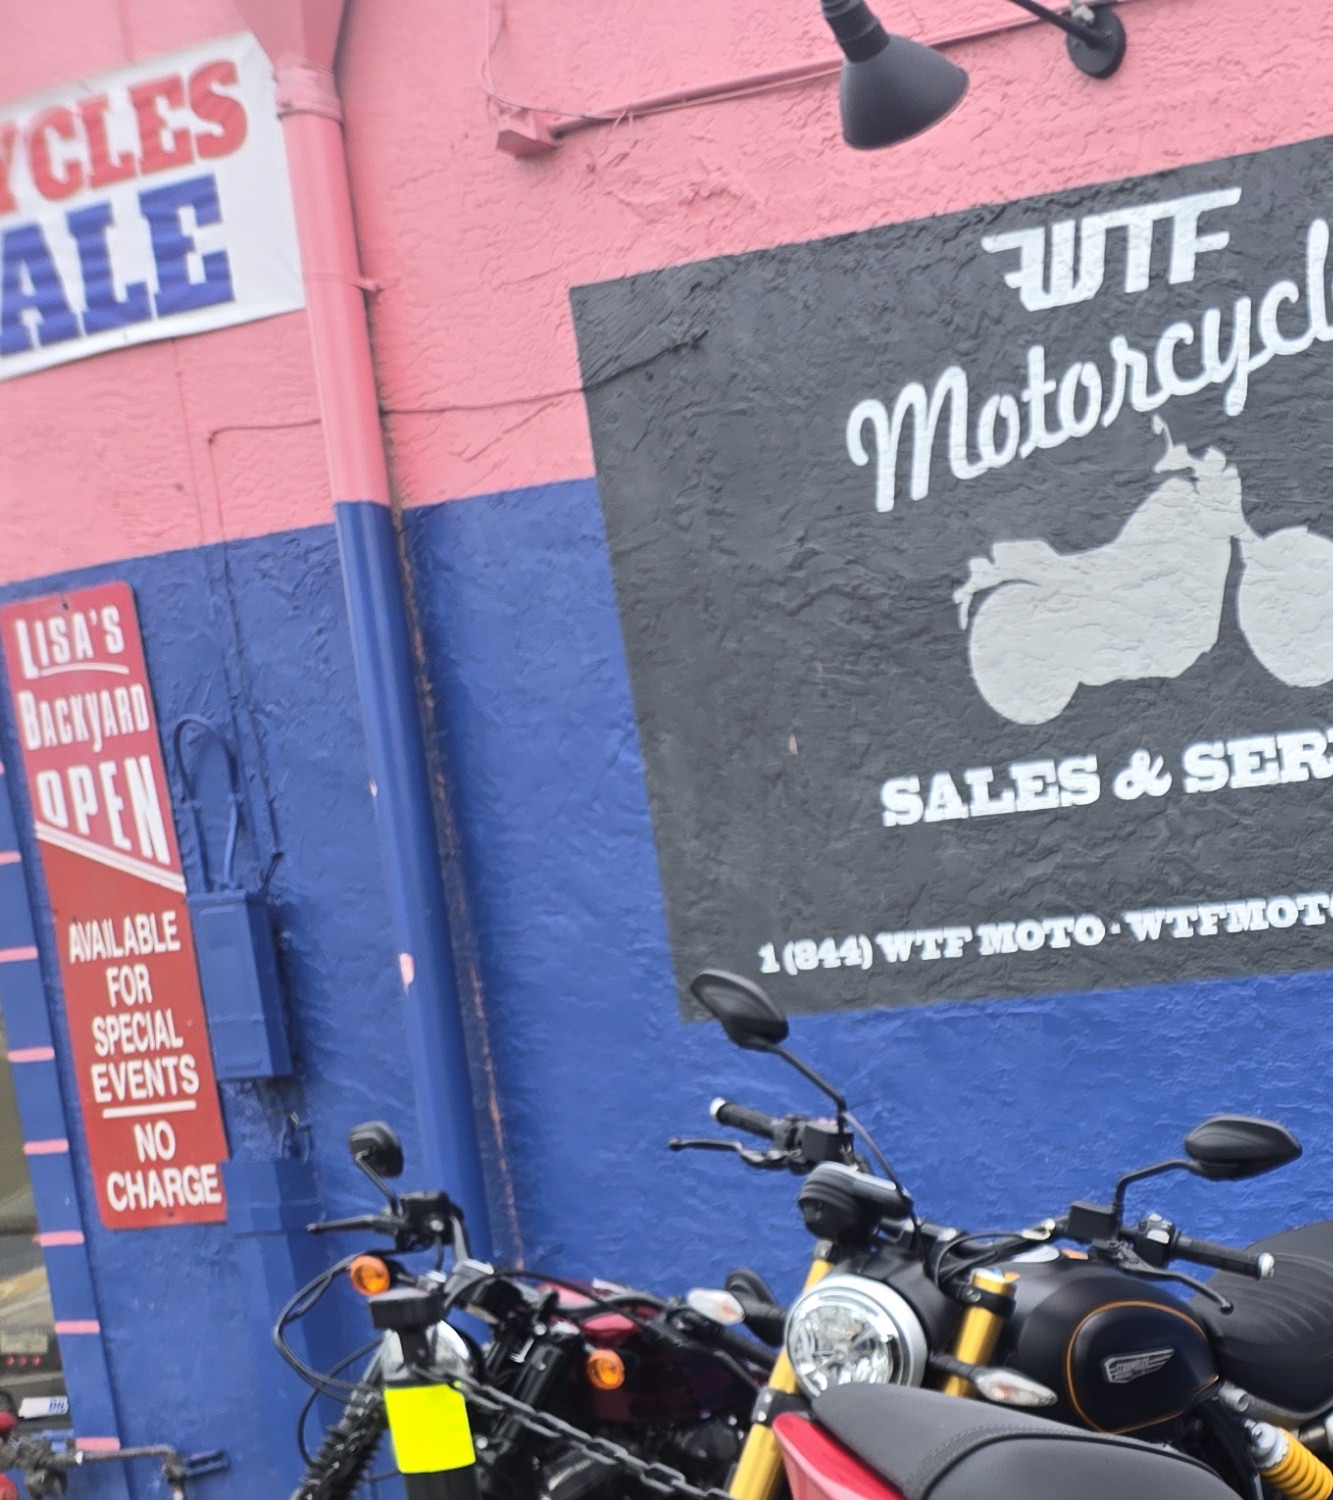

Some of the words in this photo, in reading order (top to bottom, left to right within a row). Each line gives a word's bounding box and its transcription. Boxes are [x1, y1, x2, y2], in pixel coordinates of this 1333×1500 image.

[981, 187, 1243, 312] WTF
[36, 754, 171, 866] OPEN
[881, 754, 1101, 827] SALES
[1113, 748, 1172, 801] &
[68, 910, 181, 964] AVAILABLE
[758, 942, 781, 974] 1
[782, 934, 874, 976] (844)
[875, 926, 973, 963] WTF
[977, 914, 1106, 957] MOTO
[106, 963, 153, 1008] FOR
[92, 1008, 184, 1057] SPECIAL
[90, 1054, 200, 1104] EVENTS
[133, 1120, 177, 1163] NO
[106, 1164, 223, 1212] CHARGE
